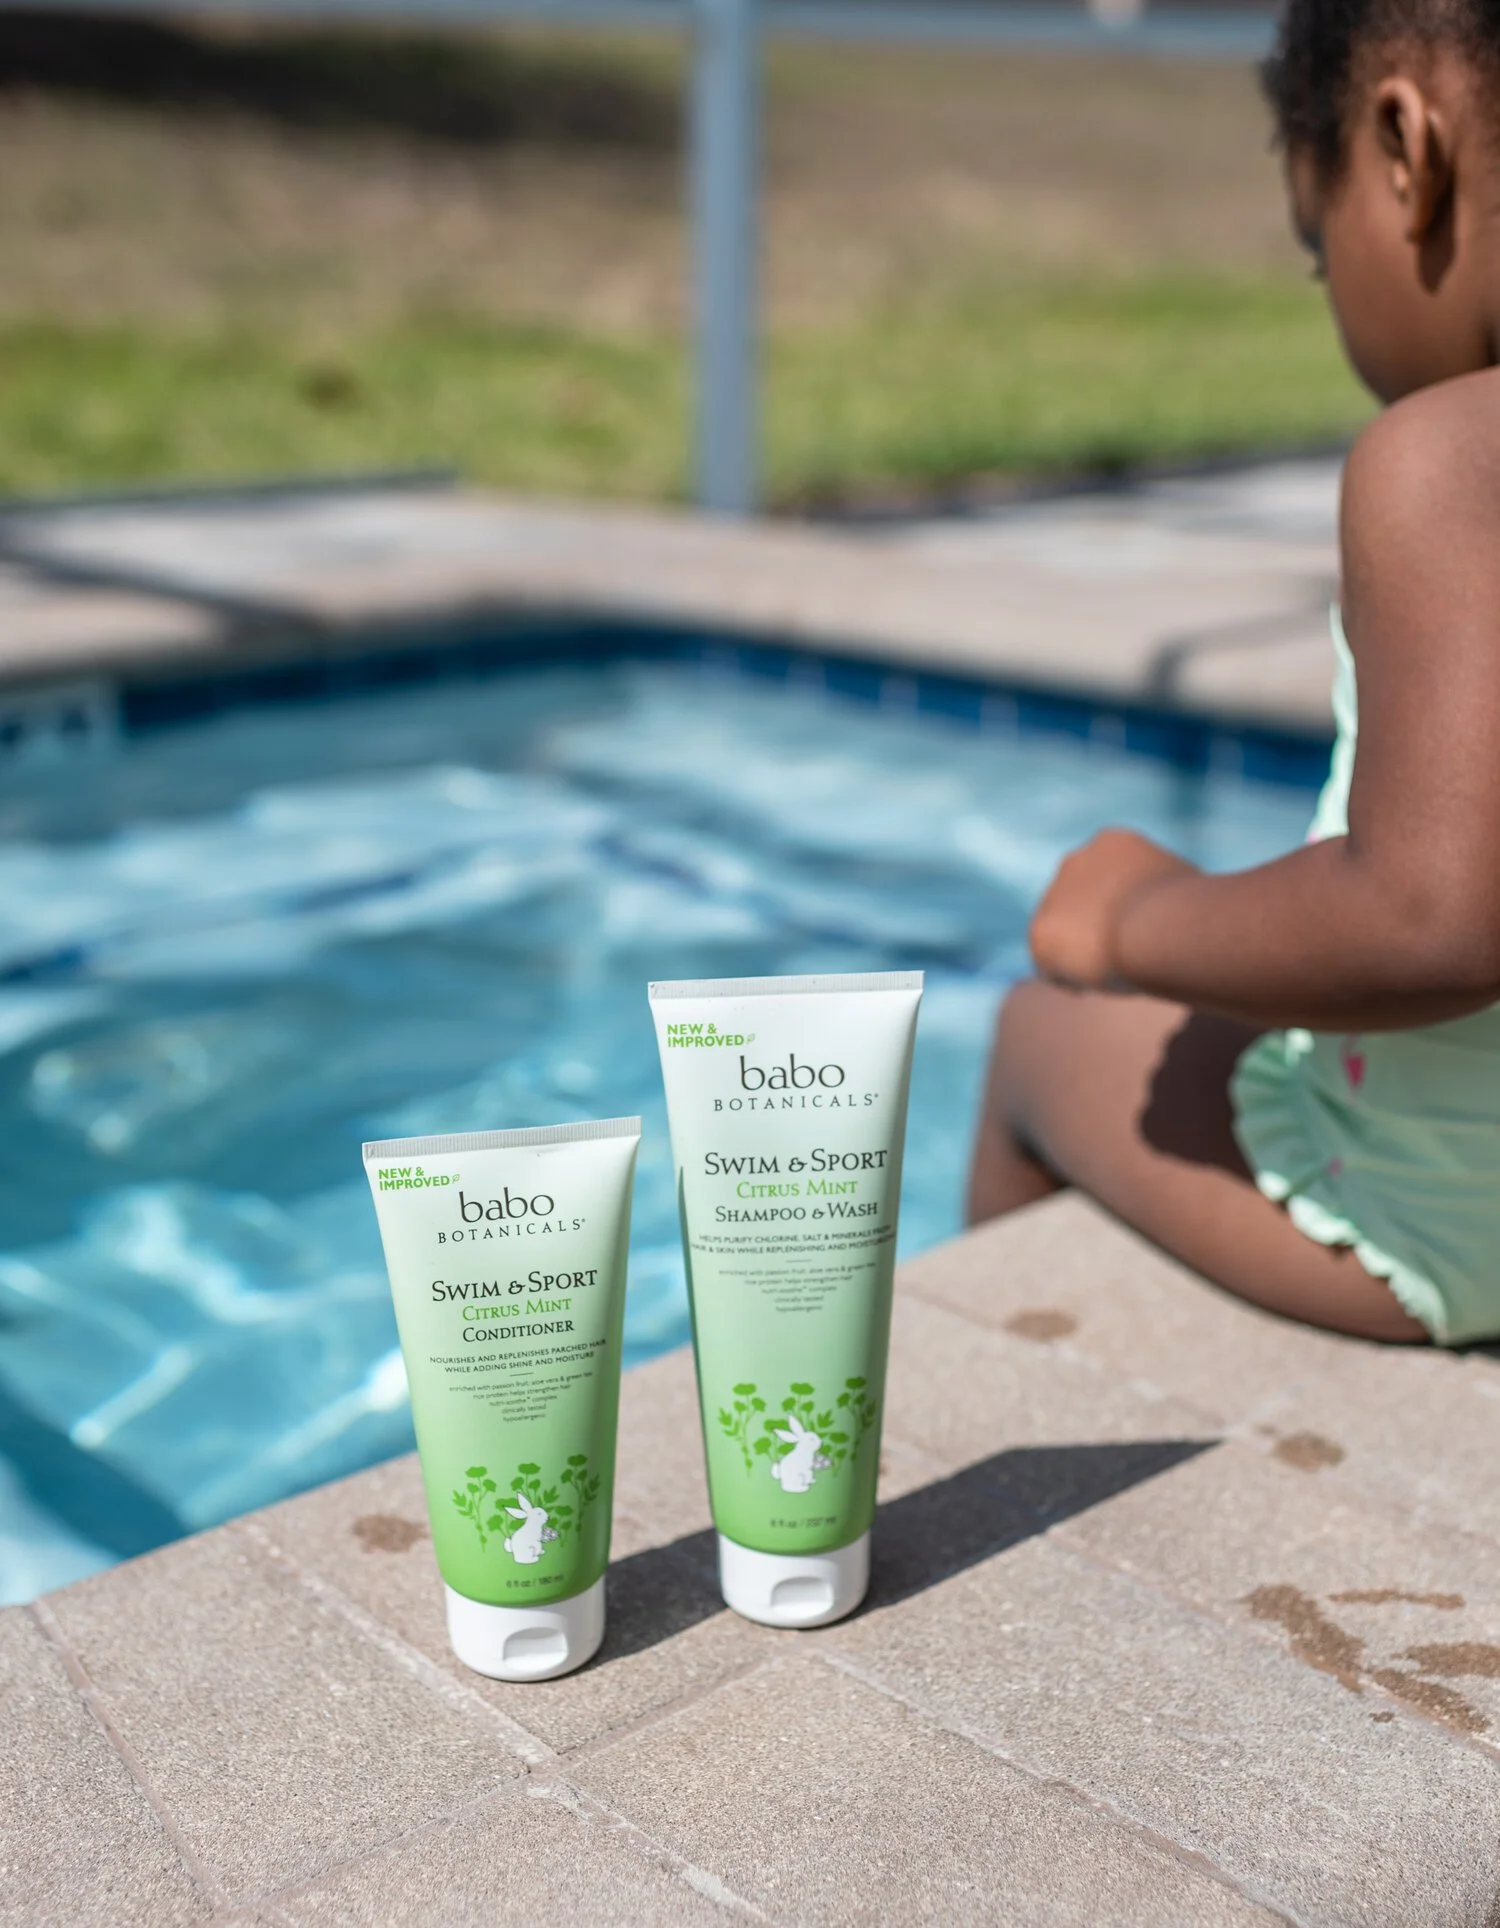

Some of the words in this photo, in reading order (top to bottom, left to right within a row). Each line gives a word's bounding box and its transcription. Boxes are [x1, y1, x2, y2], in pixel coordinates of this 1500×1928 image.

[667, 1024, 704, 1035] NEW
[707, 1023, 717, 1034] &
[668, 1035, 744, 1047] IMPROVED
[740, 1054, 845, 1091] babo
[705, 1152, 780, 1175] SWIM
[788, 1157, 808, 1172] &
[811, 1148, 888, 1172] SPORT
[378, 1167, 412, 1179] NEW
[416, 1167, 424, 1176] &
[379, 1175, 450, 1191] IMPROVED
[459, 1187, 555, 1223] babo
[812, 1208, 825, 1220] &
[699, 1234, 722, 1243] HELPS
[724, 1236, 752, 1244] PURIFY
[802, 1234, 822, 1242] SALT
[831, 1230, 871, 1240] MINERALS
[716, 1246, 735, 1254] SKIN
[737, 1246, 763, 1254] WHILE
[766, 1244, 826, 1254] REPLENISHING
[828, 1243, 847, 1251] AND
[432, 1281, 501, 1301] SWIM
[508, 1280, 525, 1294] &
[528, 1270, 597, 1292] SPORT
[430, 1356, 475, 1364] NOURISHES
[499, 1349, 549, 1361] REPLENISHES
[551, 1343, 588, 1354] PARCHED
[590, 1338, 606, 1348] HAIR
[473, 1363, 507, 1372] ADDING
[509, 1360, 532, 1369] SHINE
[555, 1351, 594, 1363] MOISTURE
